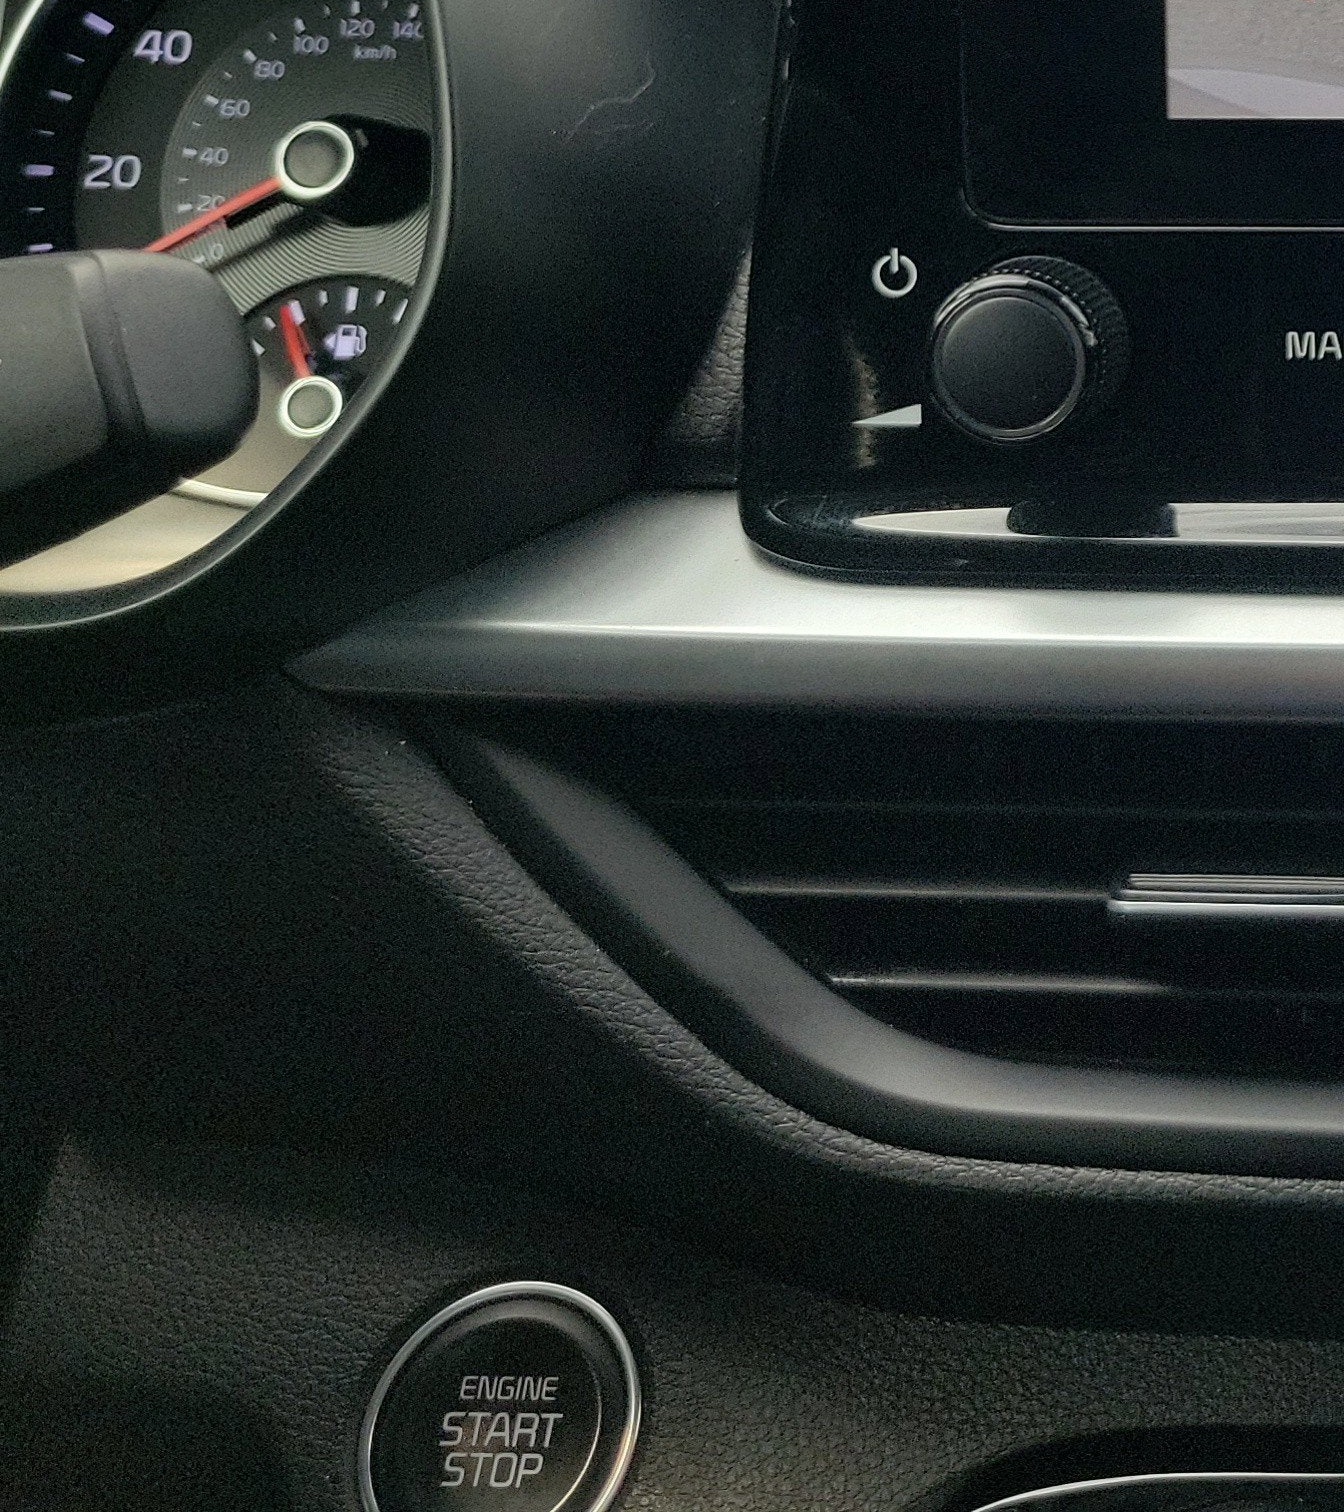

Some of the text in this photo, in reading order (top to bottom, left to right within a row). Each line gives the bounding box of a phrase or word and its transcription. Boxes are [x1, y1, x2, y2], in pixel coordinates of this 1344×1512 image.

[340, 18, 376, 39] 120
[132, 29, 193, 65] 40
[293, 34, 330, 55] 100
[354, 44, 398, 61] km/h
[253, 60, 286, 80] 80
[218, 98, 251, 118] 60
[199, 147, 229, 167] 40
[82, 153, 143, 190] 20
[459, 1375, 560, 1401] ENGINE
[439, 1411, 564, 1448] START
[439, 1452, 544, 1489] STOP
